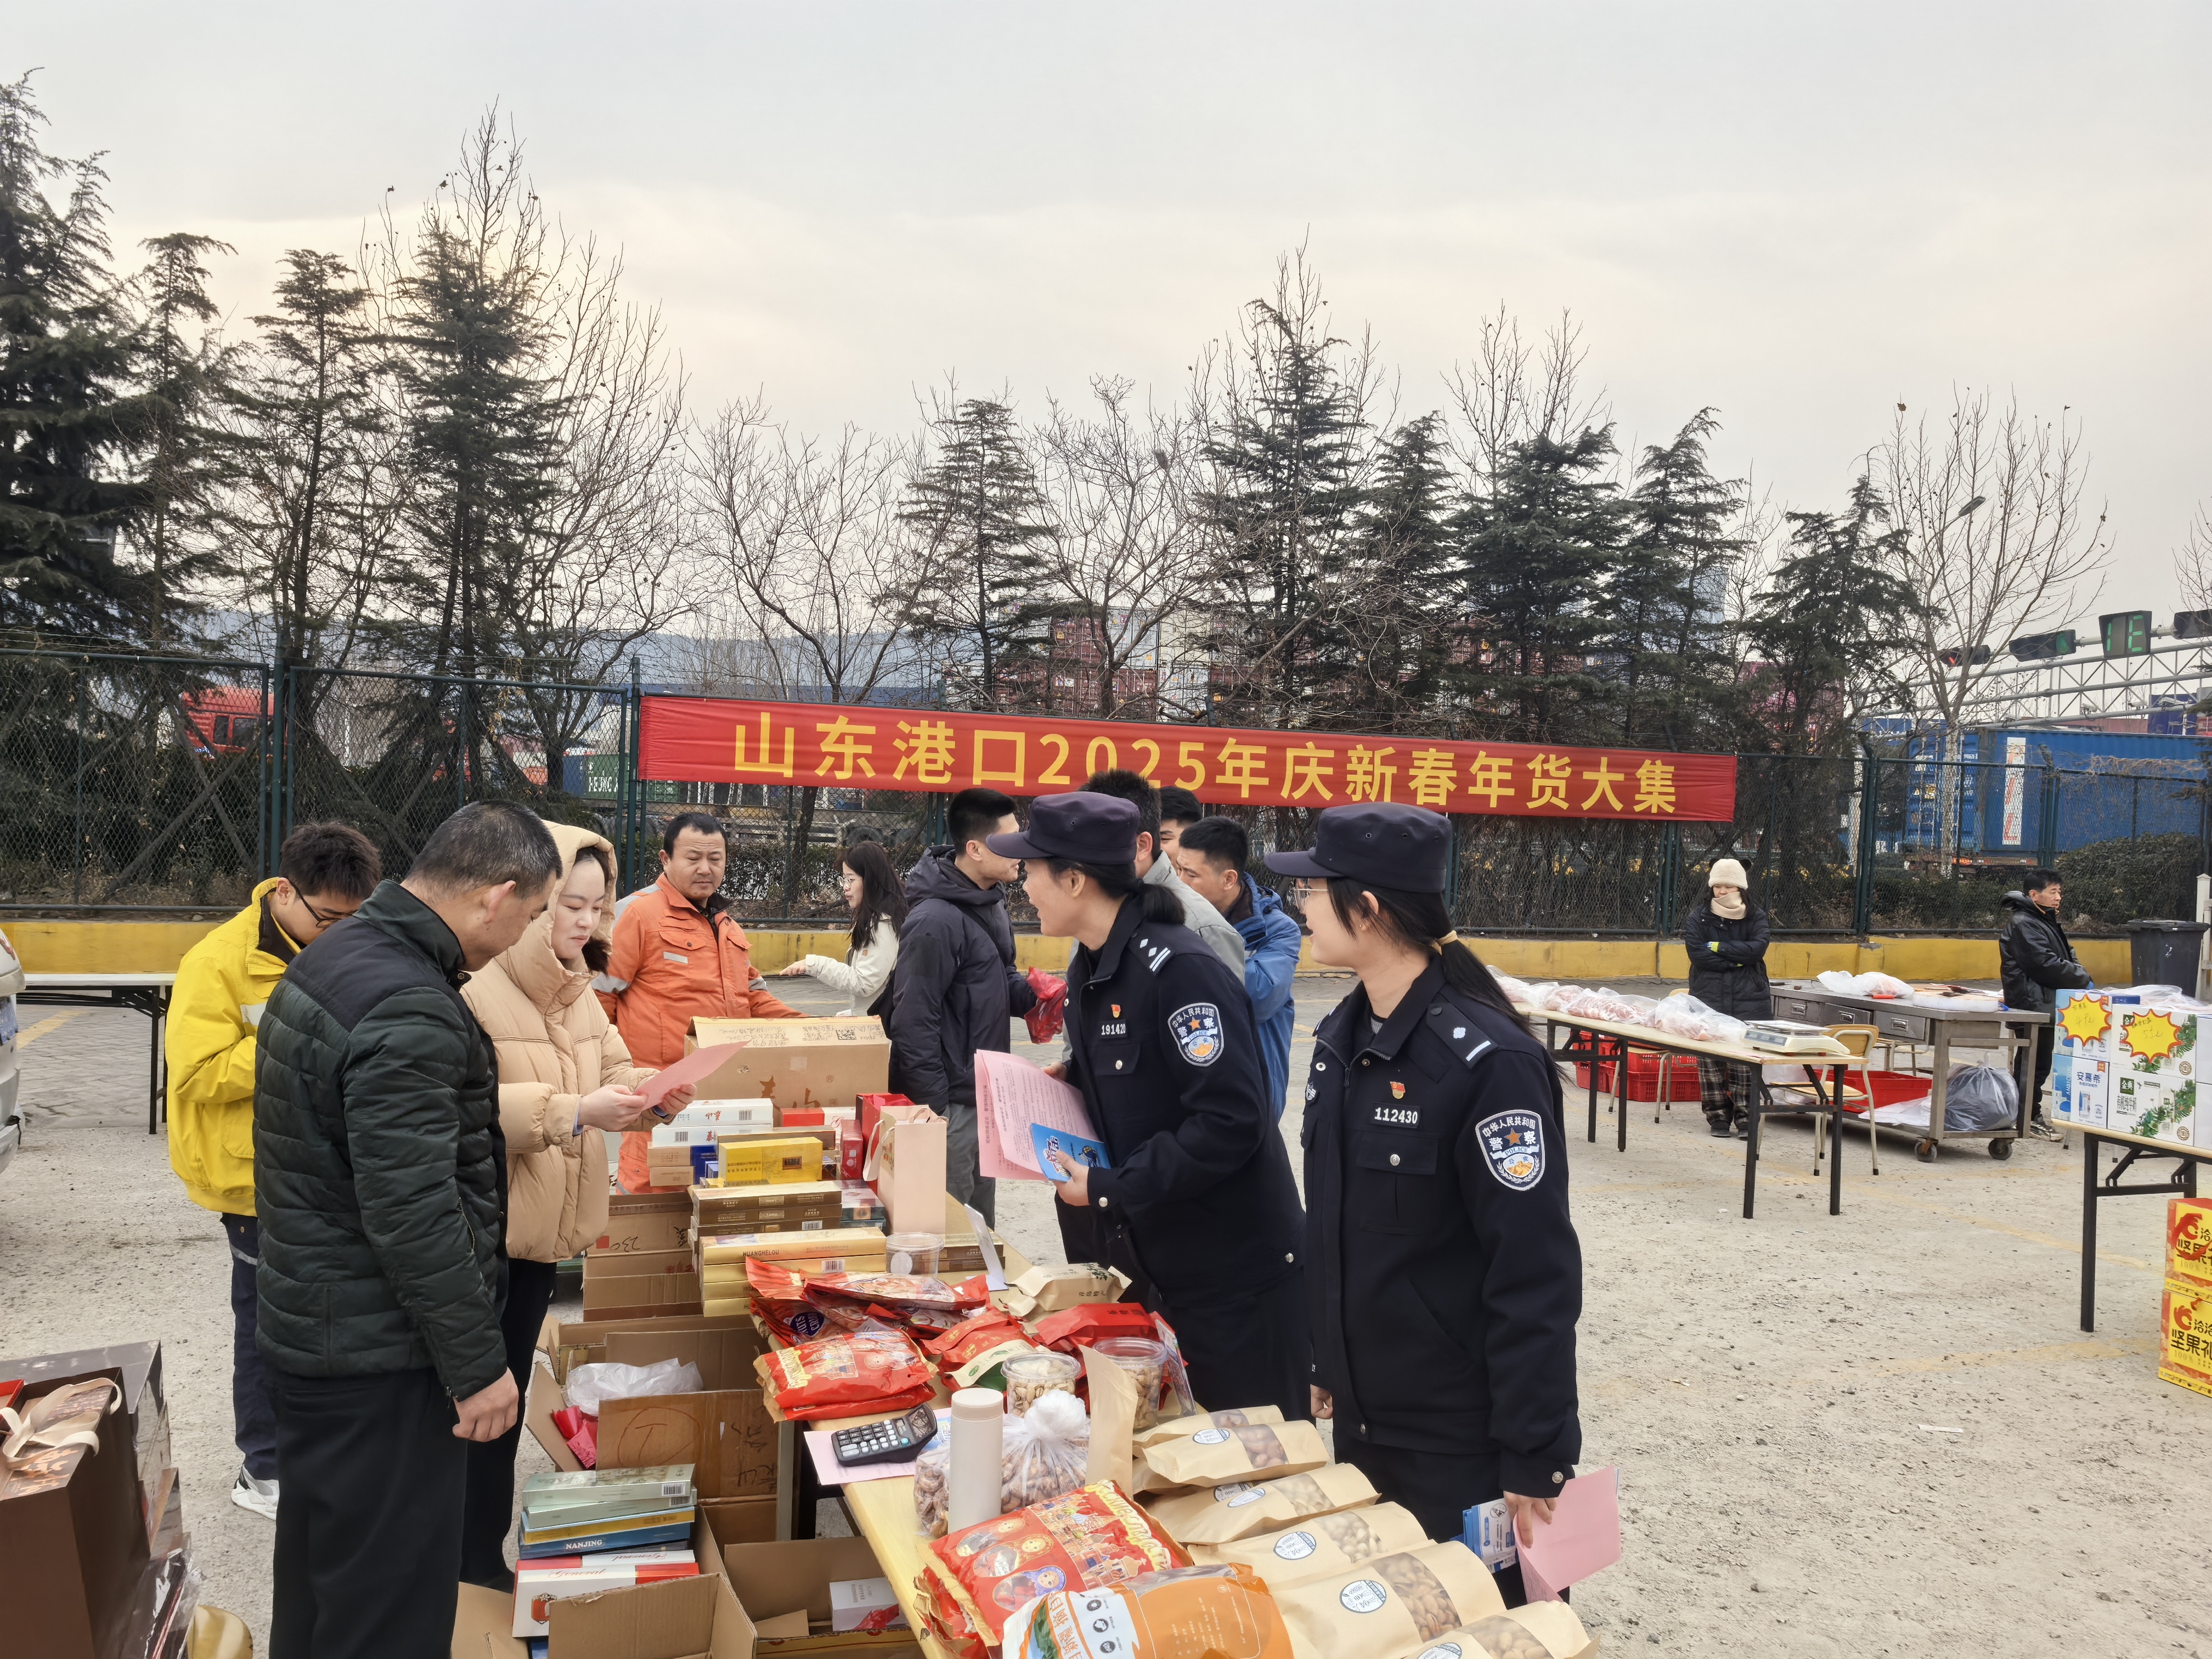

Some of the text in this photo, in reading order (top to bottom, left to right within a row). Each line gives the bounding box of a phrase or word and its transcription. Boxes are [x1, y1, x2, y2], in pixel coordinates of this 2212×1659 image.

[735, 712, 1676, 814] 山东港口2025年庆新春年货大集
[1172, 1007, 1214, 1028] 中华人民共和国
[1101, 1023, 1126, 1035] 191420
[1189, 1030, 1208, 1041] POLICE
[1374, 1107, 1418, 1124] 112430
[1482, 1116, 1536, 1137] 中华人民共和国
[1504, 1147, 1528, 1156] POLICE
[566, 1540, 603, 1549] NANJING
[548, 1568, 606, 1579] General
